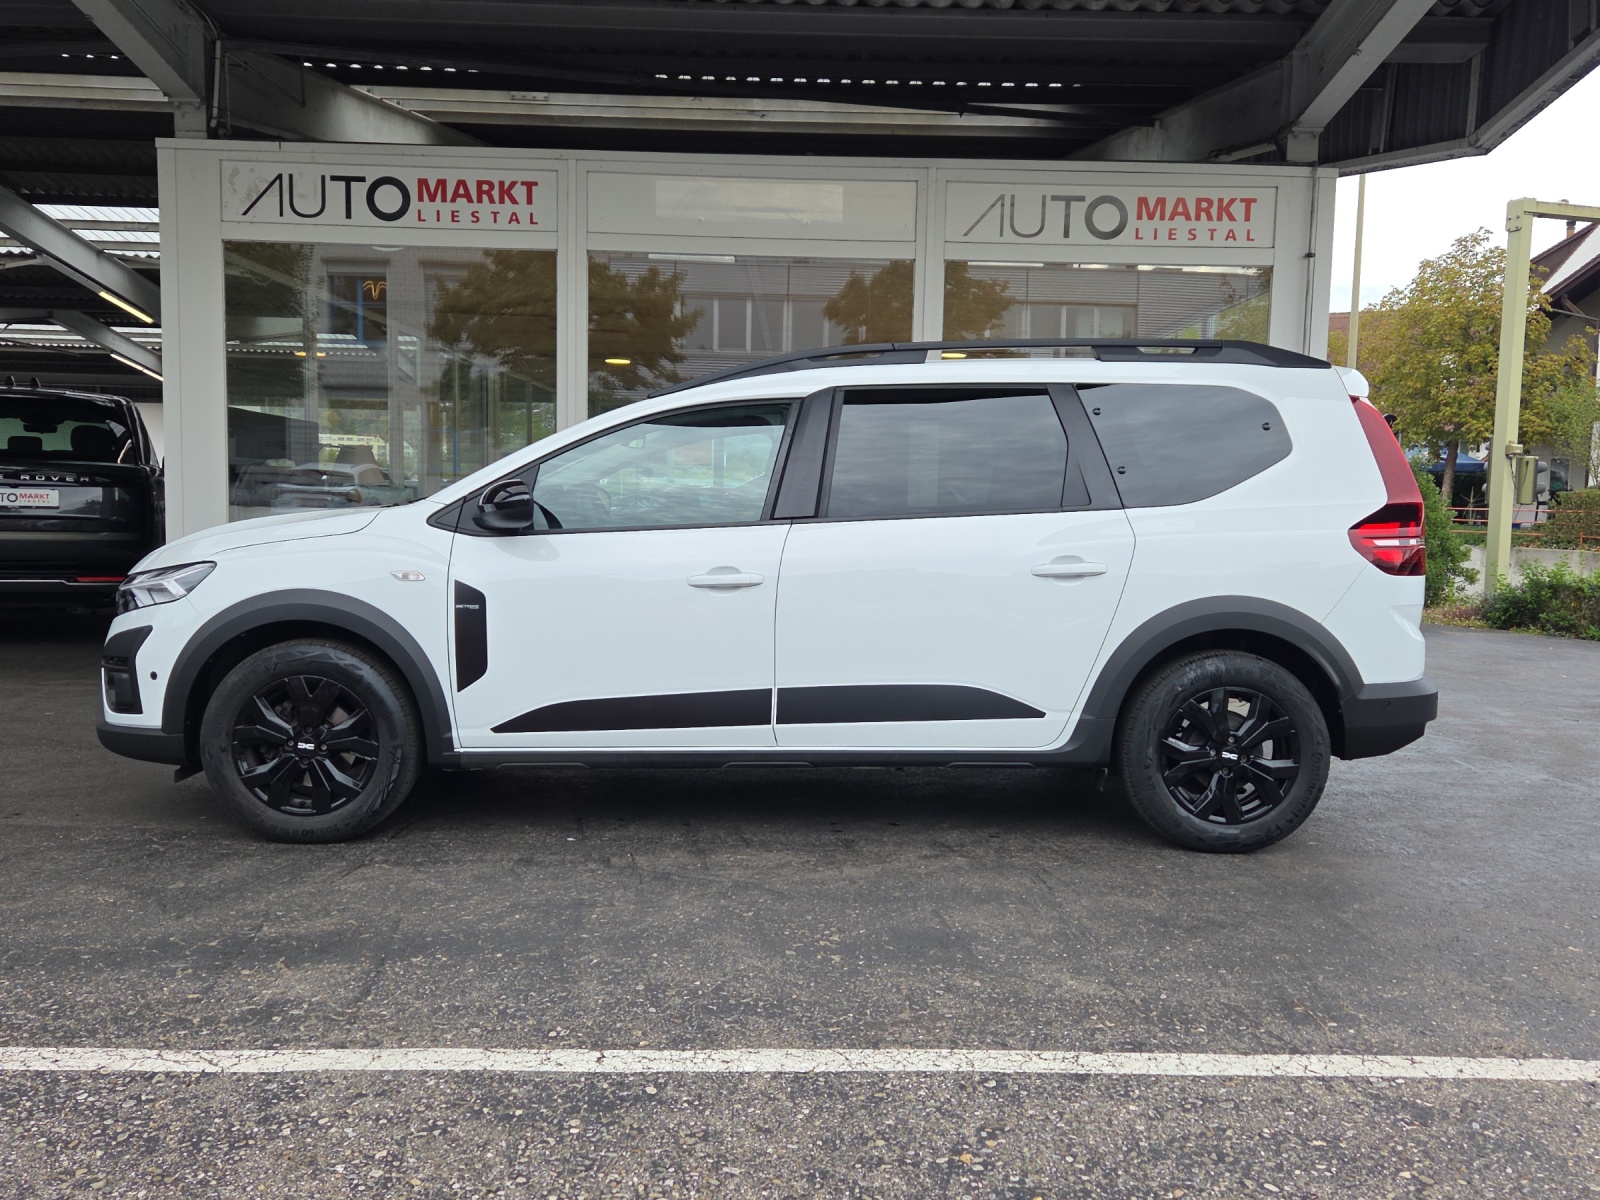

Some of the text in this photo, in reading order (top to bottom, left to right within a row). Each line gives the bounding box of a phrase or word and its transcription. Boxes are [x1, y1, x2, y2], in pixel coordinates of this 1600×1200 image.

[241, 173, 538, 221] AUTO MARKT
[417, 209, 538, 225] LIESTAL
[962, 194, 1257, 240] AUTO MARKT
[1135, 228, 1255, 241] LIESTAL
